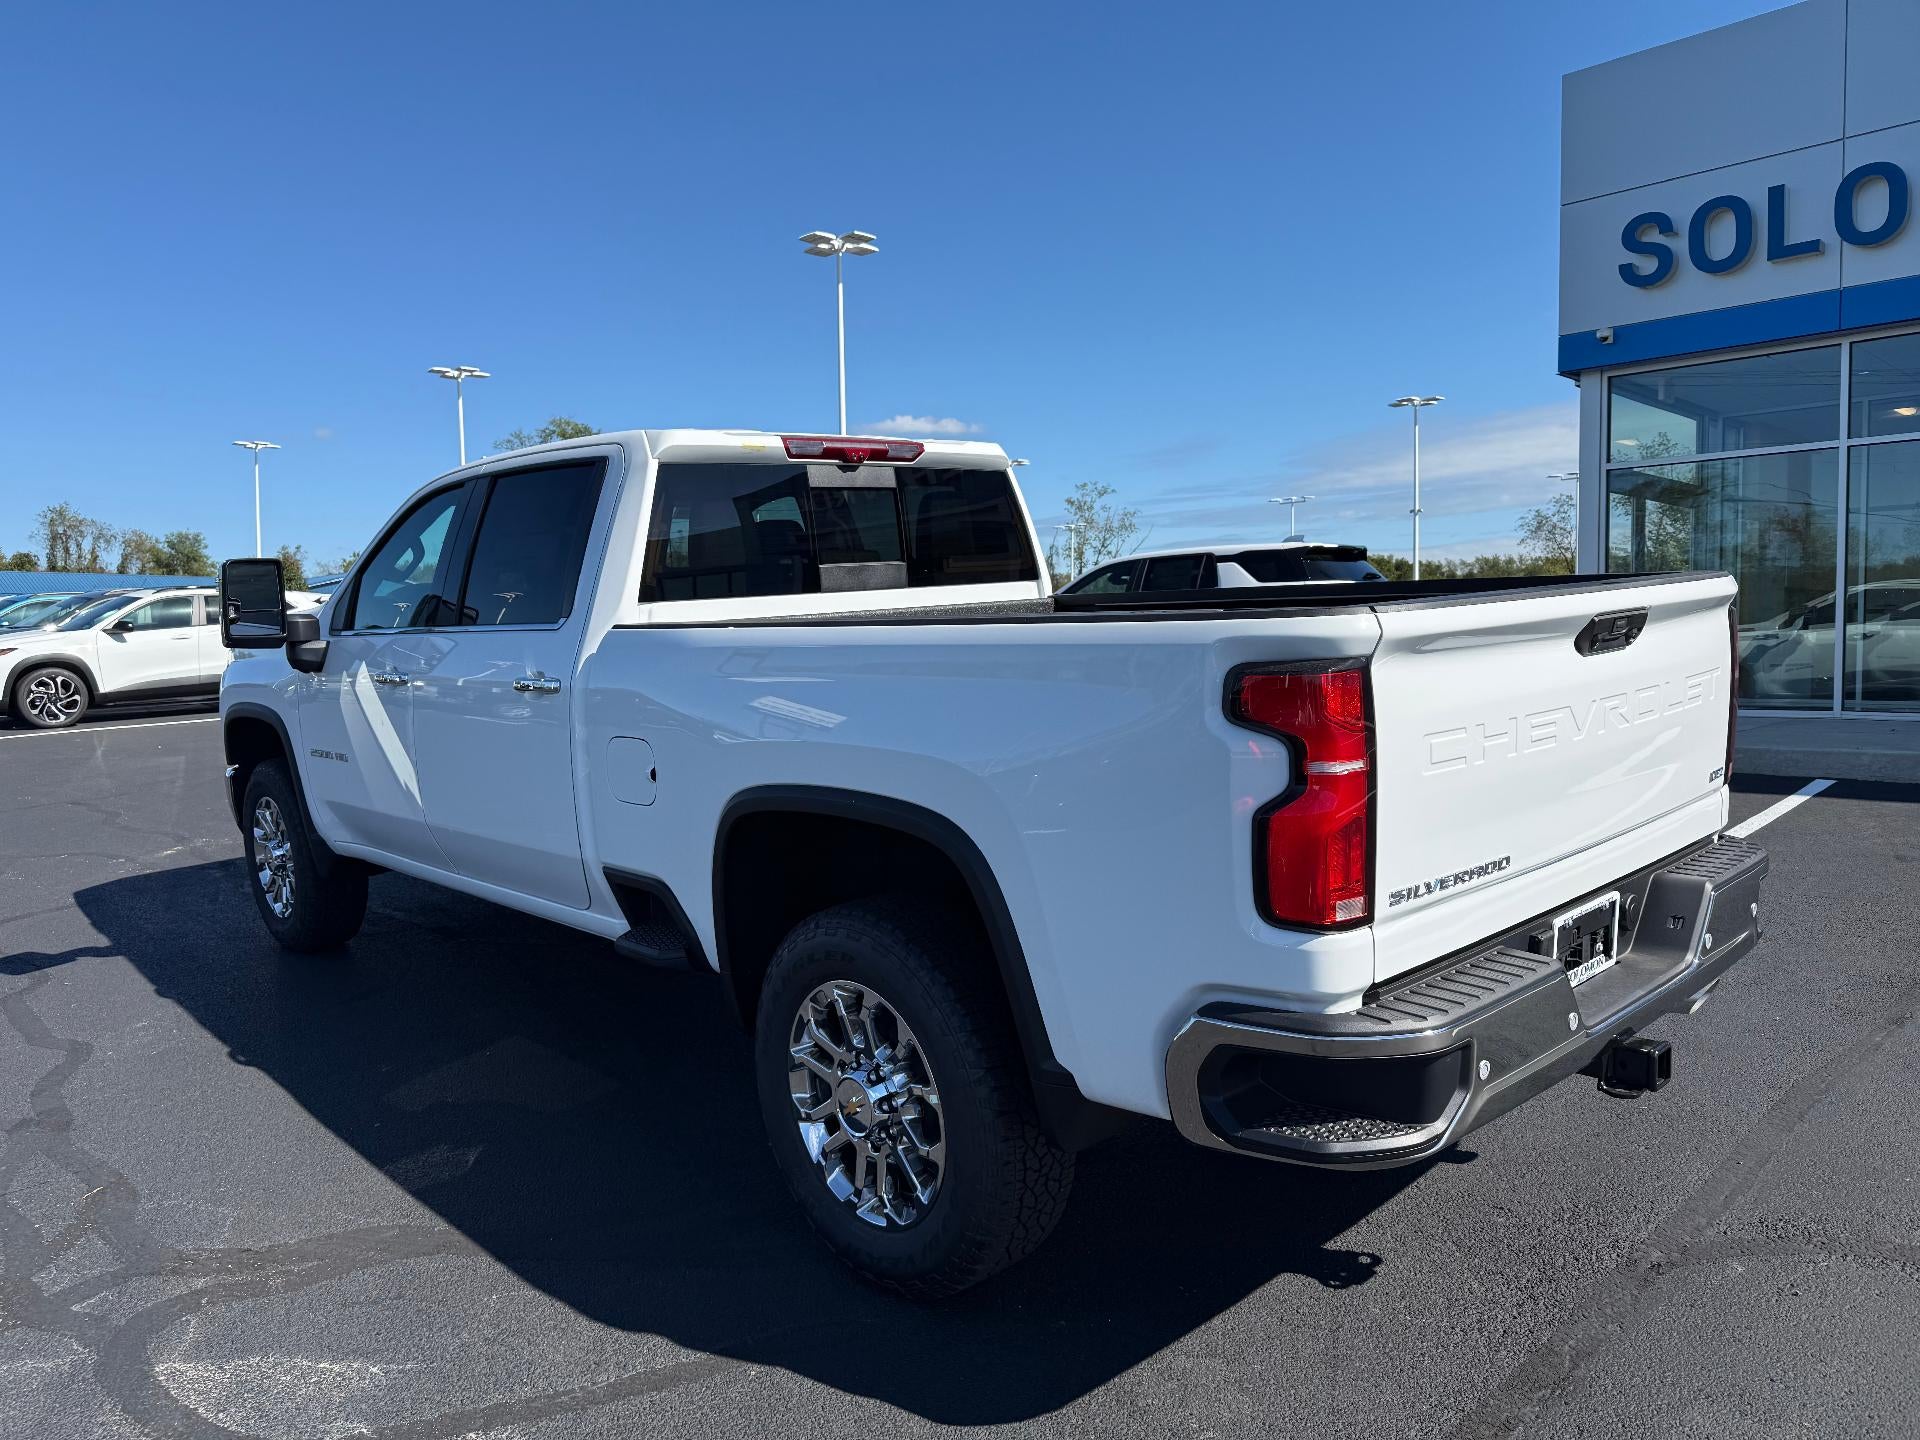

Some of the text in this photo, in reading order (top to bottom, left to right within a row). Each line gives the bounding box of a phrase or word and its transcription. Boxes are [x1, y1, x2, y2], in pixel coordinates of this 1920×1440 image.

[1618, 161, 1910, 289] SOLO
[1422, 667, 1721, 775] CHEVROLET
[1388, 855, 1511, 908] SILVERADO
[1568, 955, 1606, 983] OLOMON
